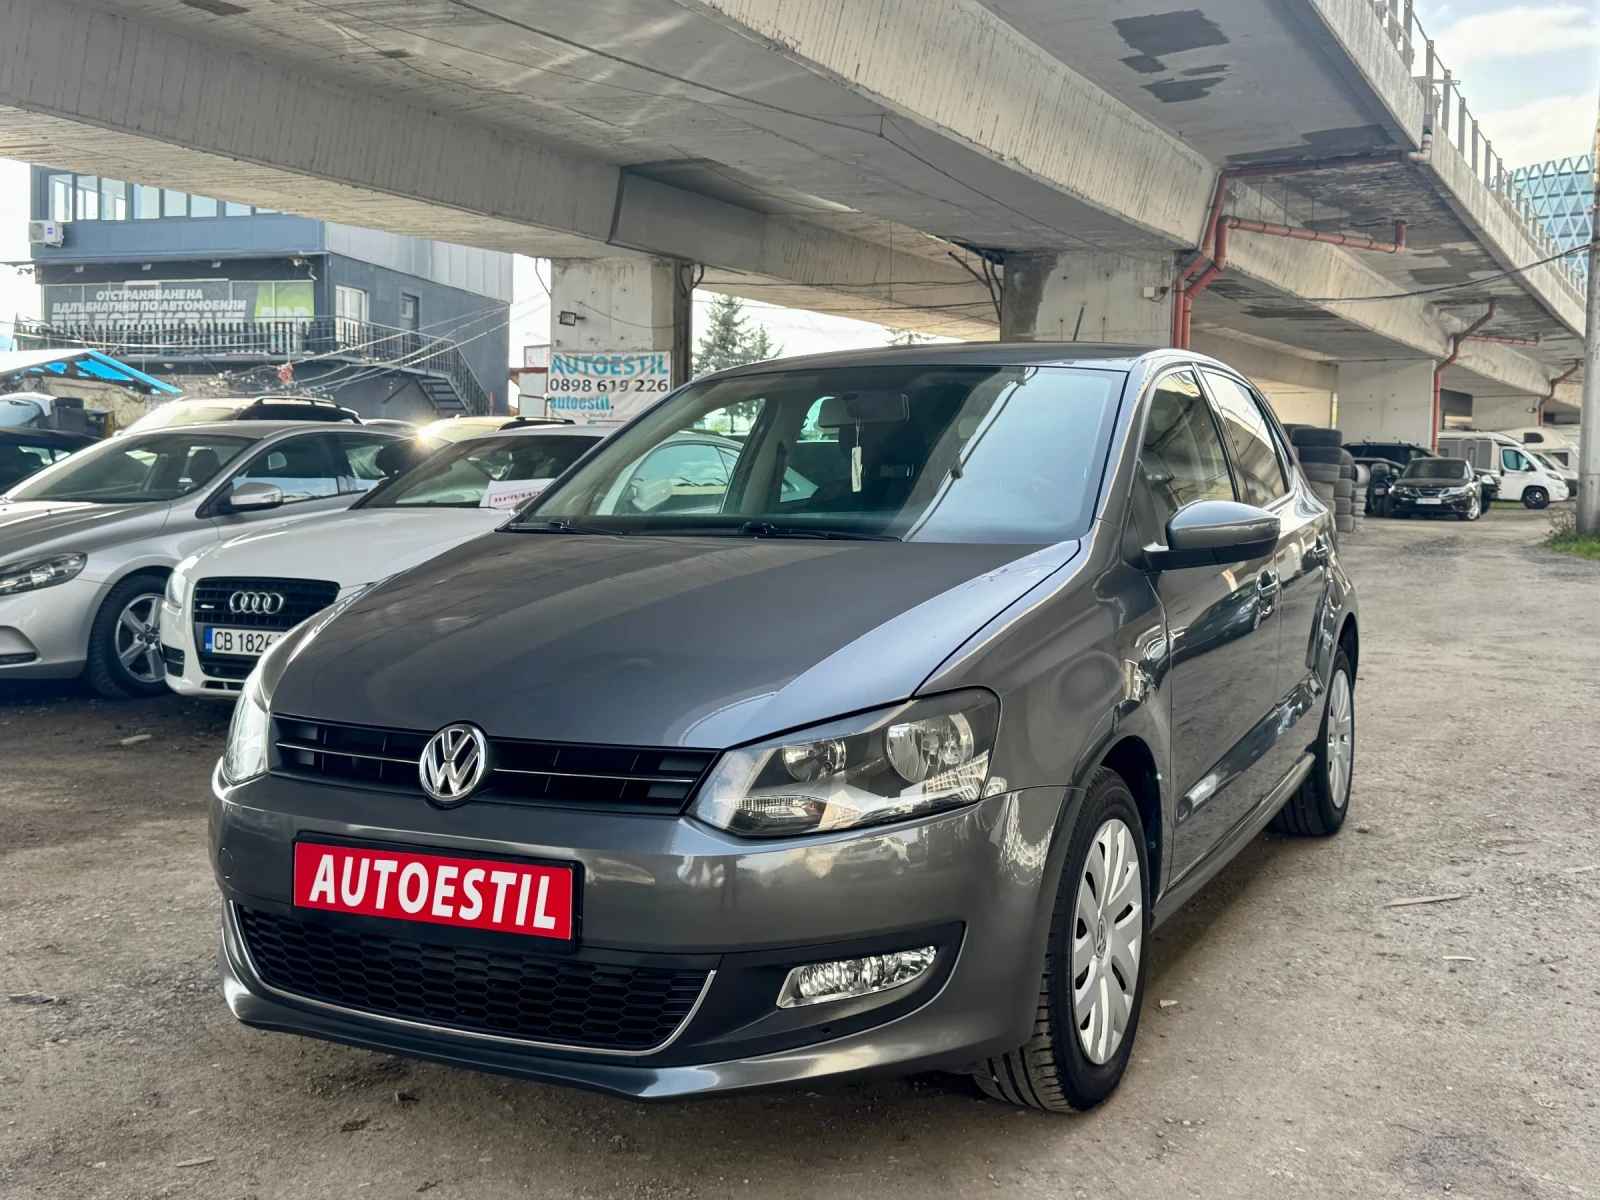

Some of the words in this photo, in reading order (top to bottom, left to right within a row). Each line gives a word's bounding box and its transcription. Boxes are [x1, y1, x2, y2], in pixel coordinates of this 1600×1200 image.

[140, 301, 159, 312] ПО
[161, 299, 247, 312] АВТОМОБИЛИ
[551, 355, 669, 375] AUTOESTIL
[550, 379, 592, 392] 0898
[597, 379, 629, 392] 619
[634, 379, 669, 392] 226
[215, 631, 233, 651] CB
[308, 854, 556, 930] AUTOESTIL
